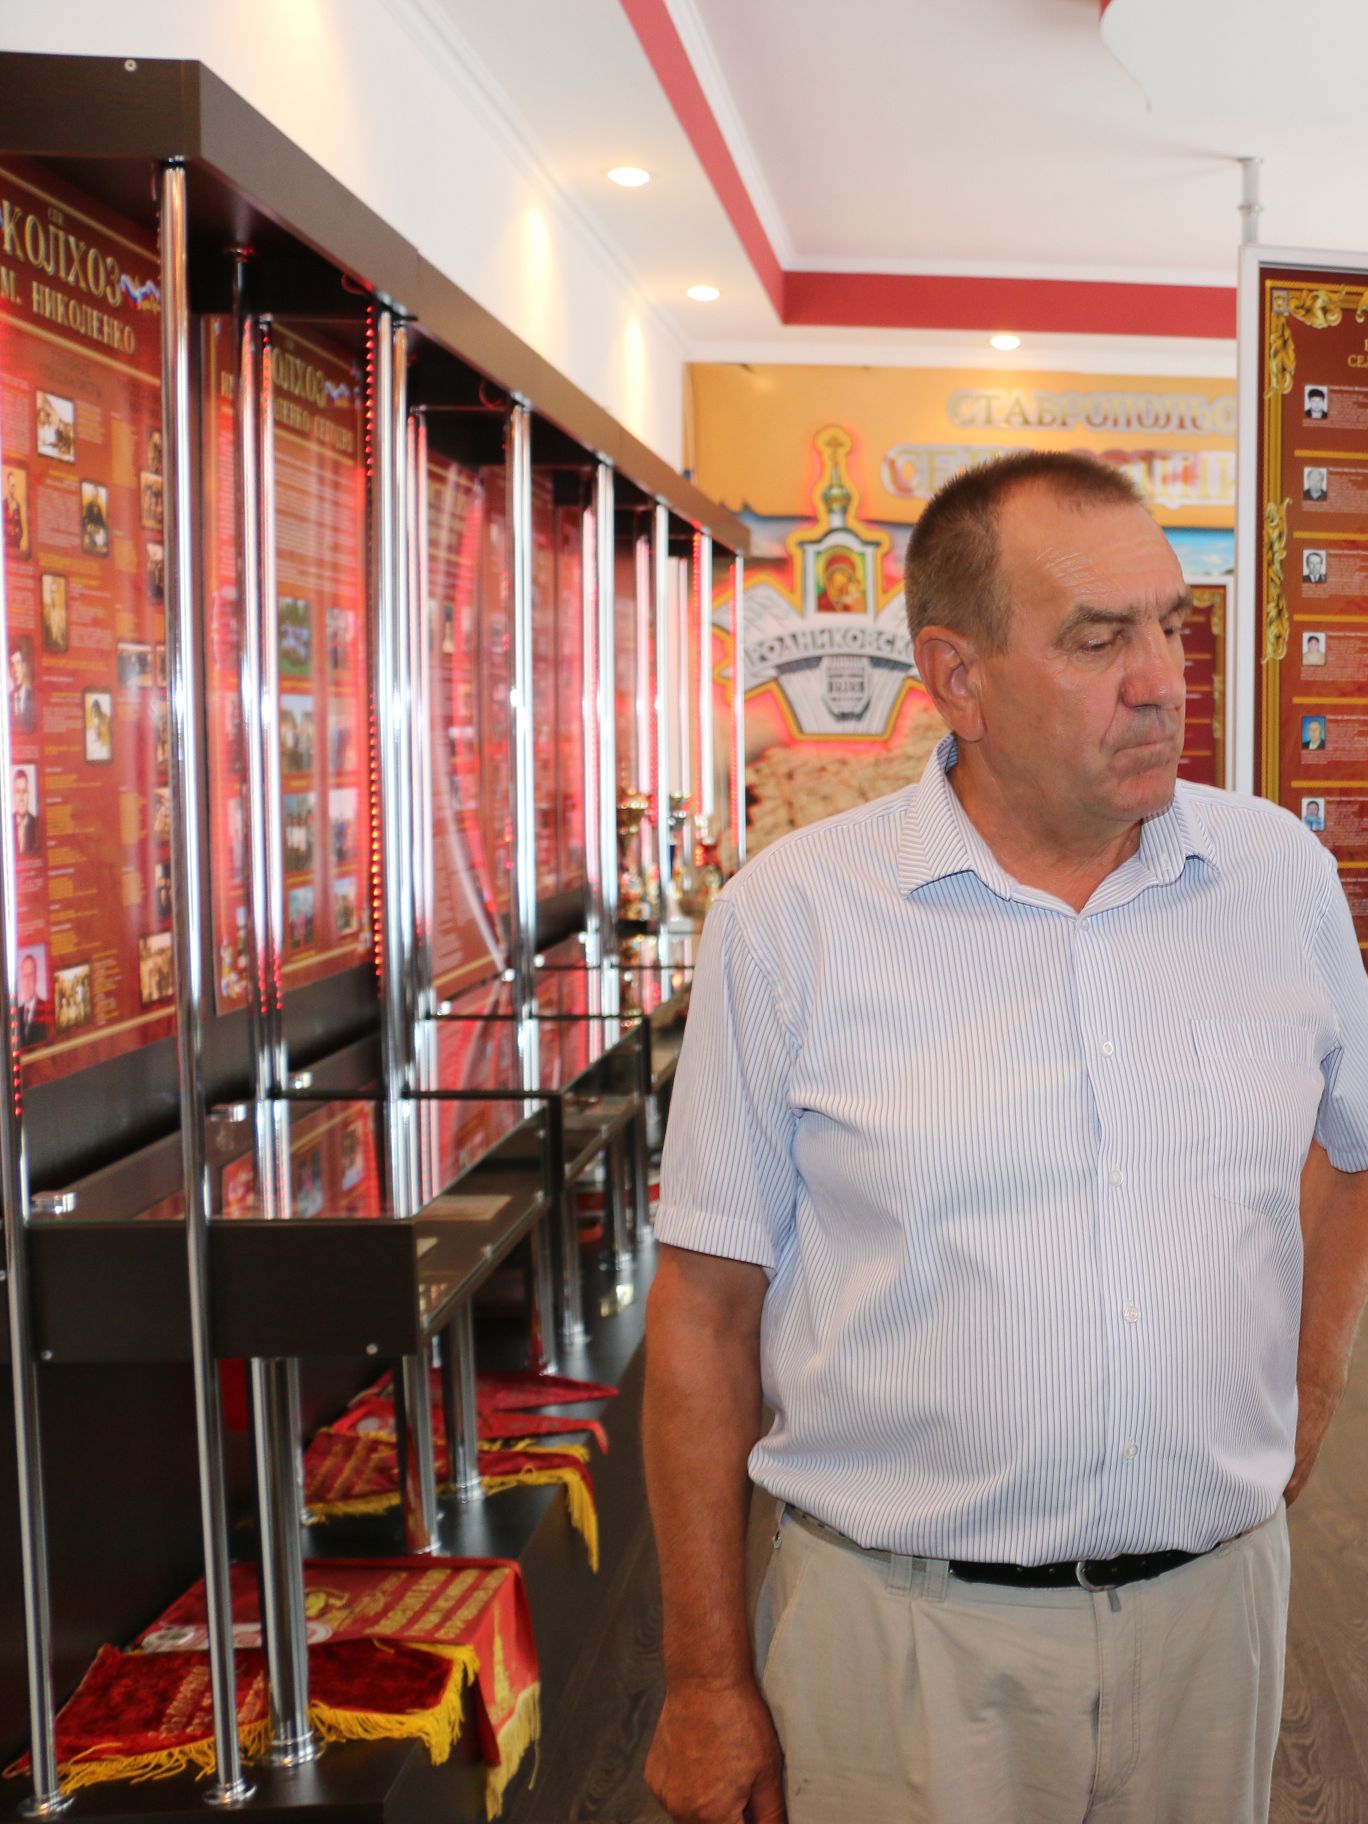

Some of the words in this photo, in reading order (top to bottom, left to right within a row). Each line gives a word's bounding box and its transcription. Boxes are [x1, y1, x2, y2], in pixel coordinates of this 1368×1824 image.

[2, 199, 123, 308] КОЛХОЗ
[31, 280, 136, 356] НИКОЛЕНКО
[271, 348, 327, 409] ОЛХОЗ
